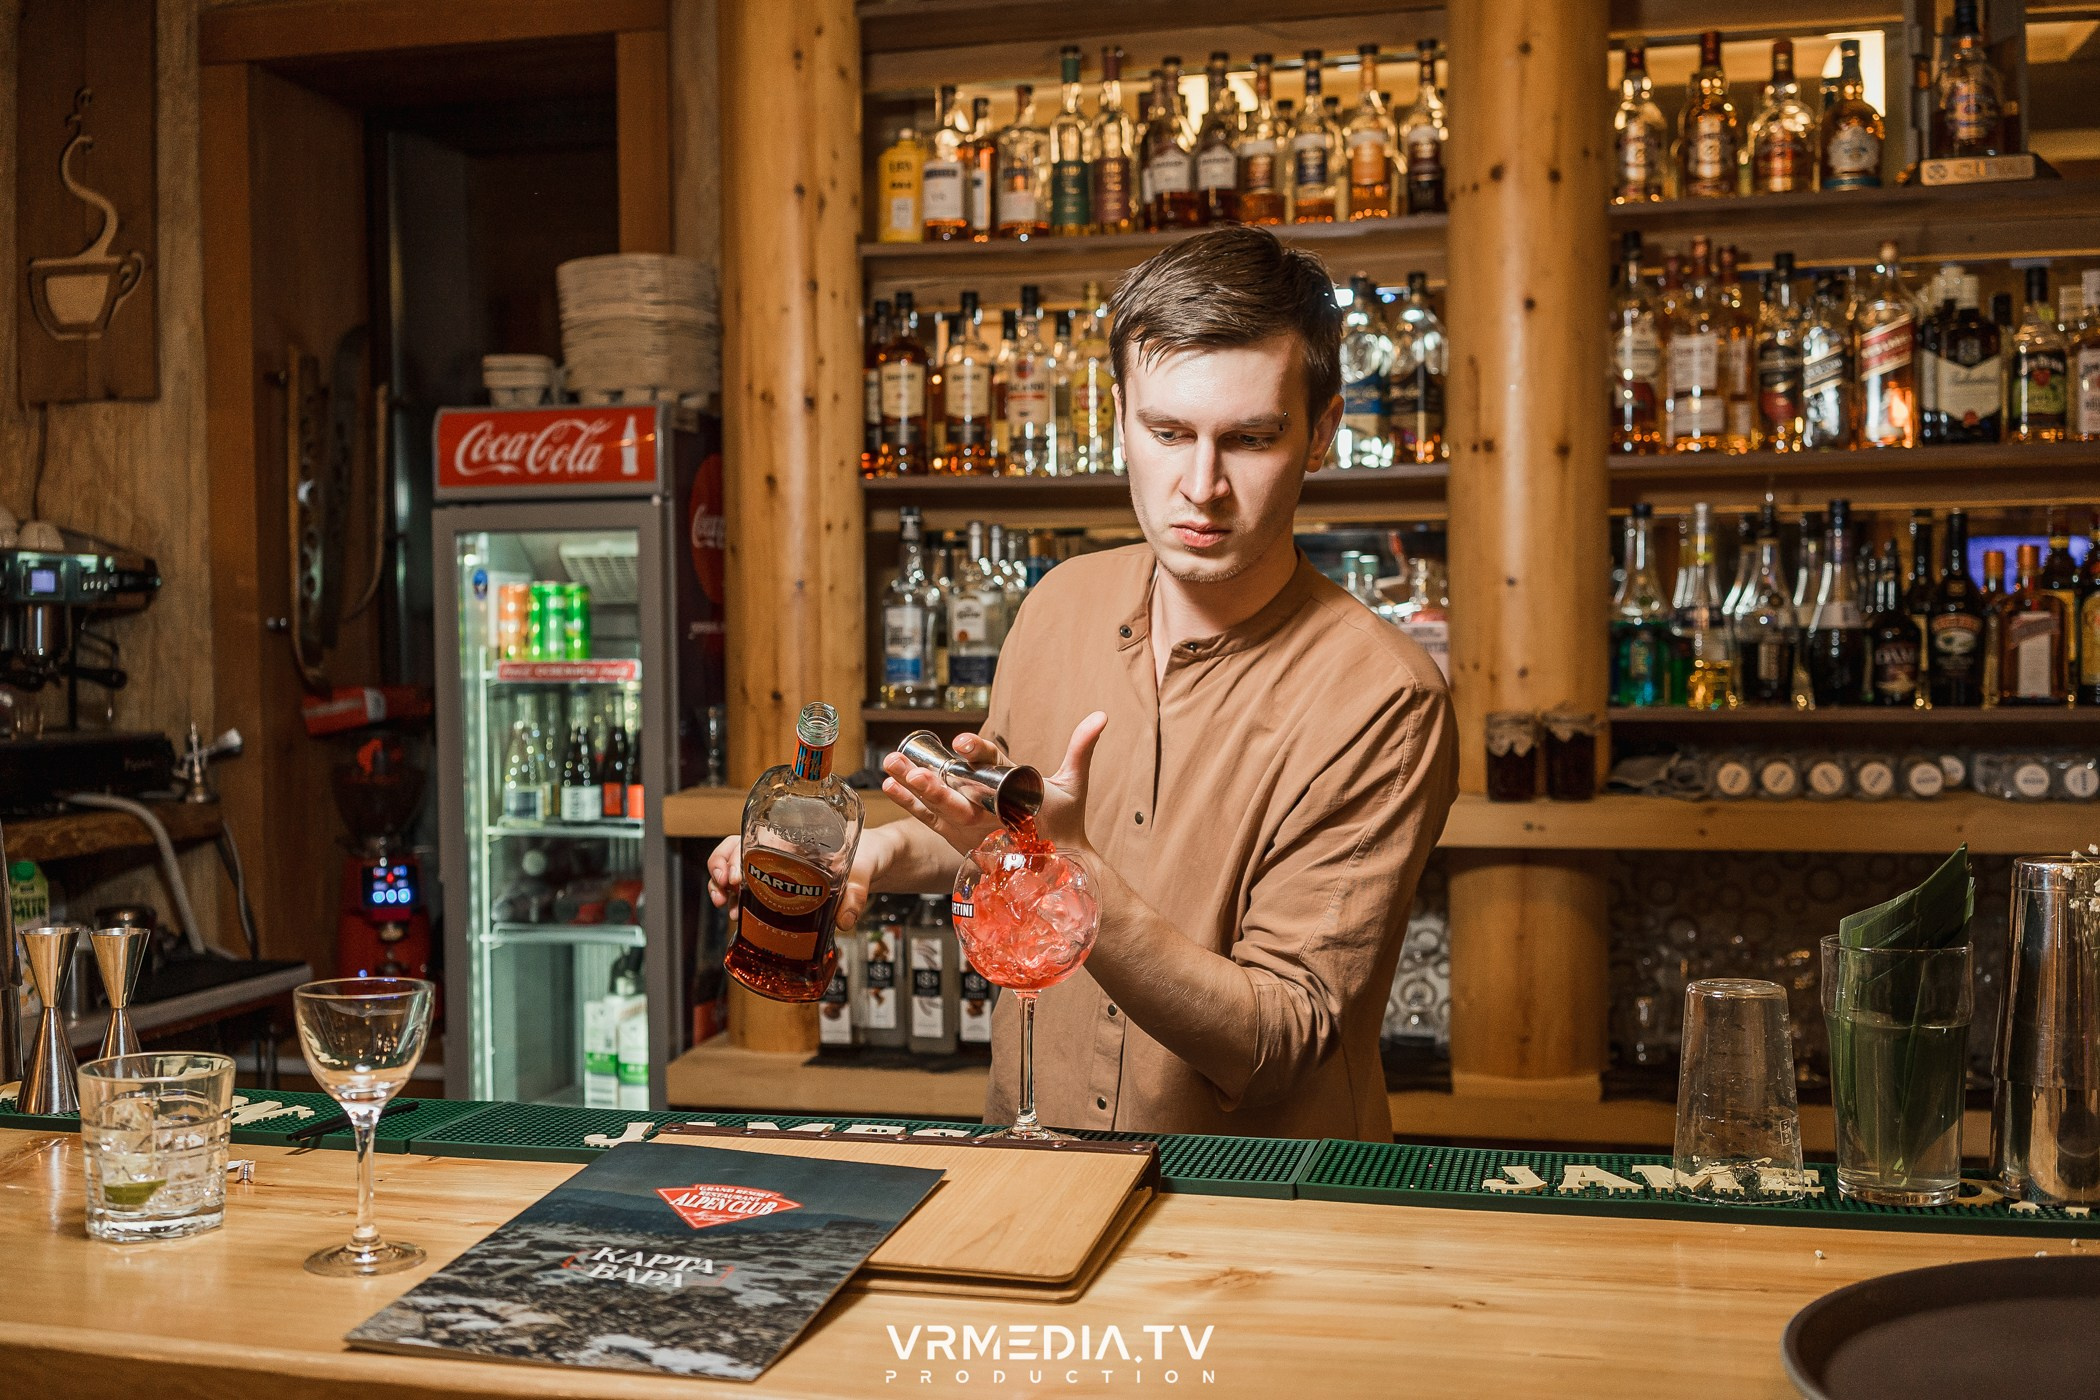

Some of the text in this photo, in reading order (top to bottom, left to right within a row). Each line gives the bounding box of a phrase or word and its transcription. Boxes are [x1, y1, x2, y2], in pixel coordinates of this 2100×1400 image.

[749, 863, 822, 897] MARTINI
[670, 1192, 778, 1216] ALPEN CLUB
[698, 1190, 763, 1202] RESTAURANT
[699, 1186, 774, 1199] GRAND RESORT
[589, 1246, 714, 1275] КАРТА
